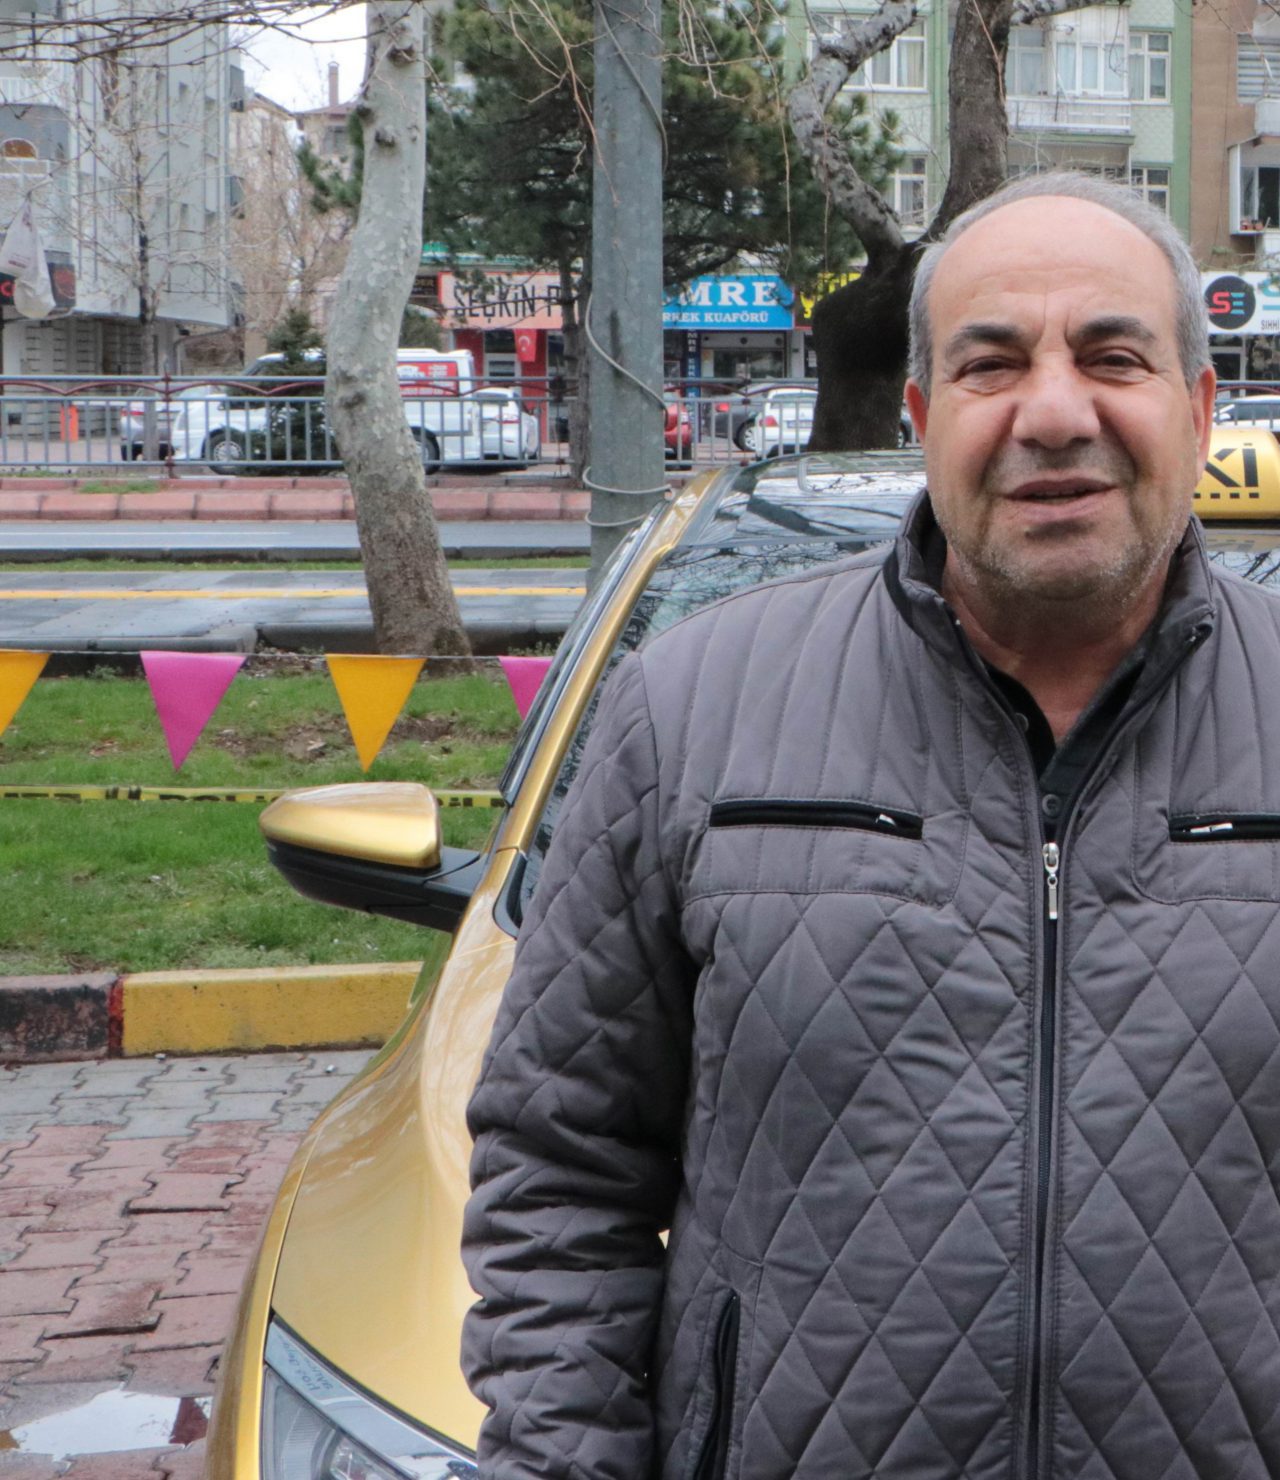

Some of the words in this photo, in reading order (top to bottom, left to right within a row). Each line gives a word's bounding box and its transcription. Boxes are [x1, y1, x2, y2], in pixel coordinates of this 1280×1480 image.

[662, 281, 780, 307] MRE
[662, 312, 700, 323] RKEK
[704, 310, 769, 323] KUAFÖRÜ
